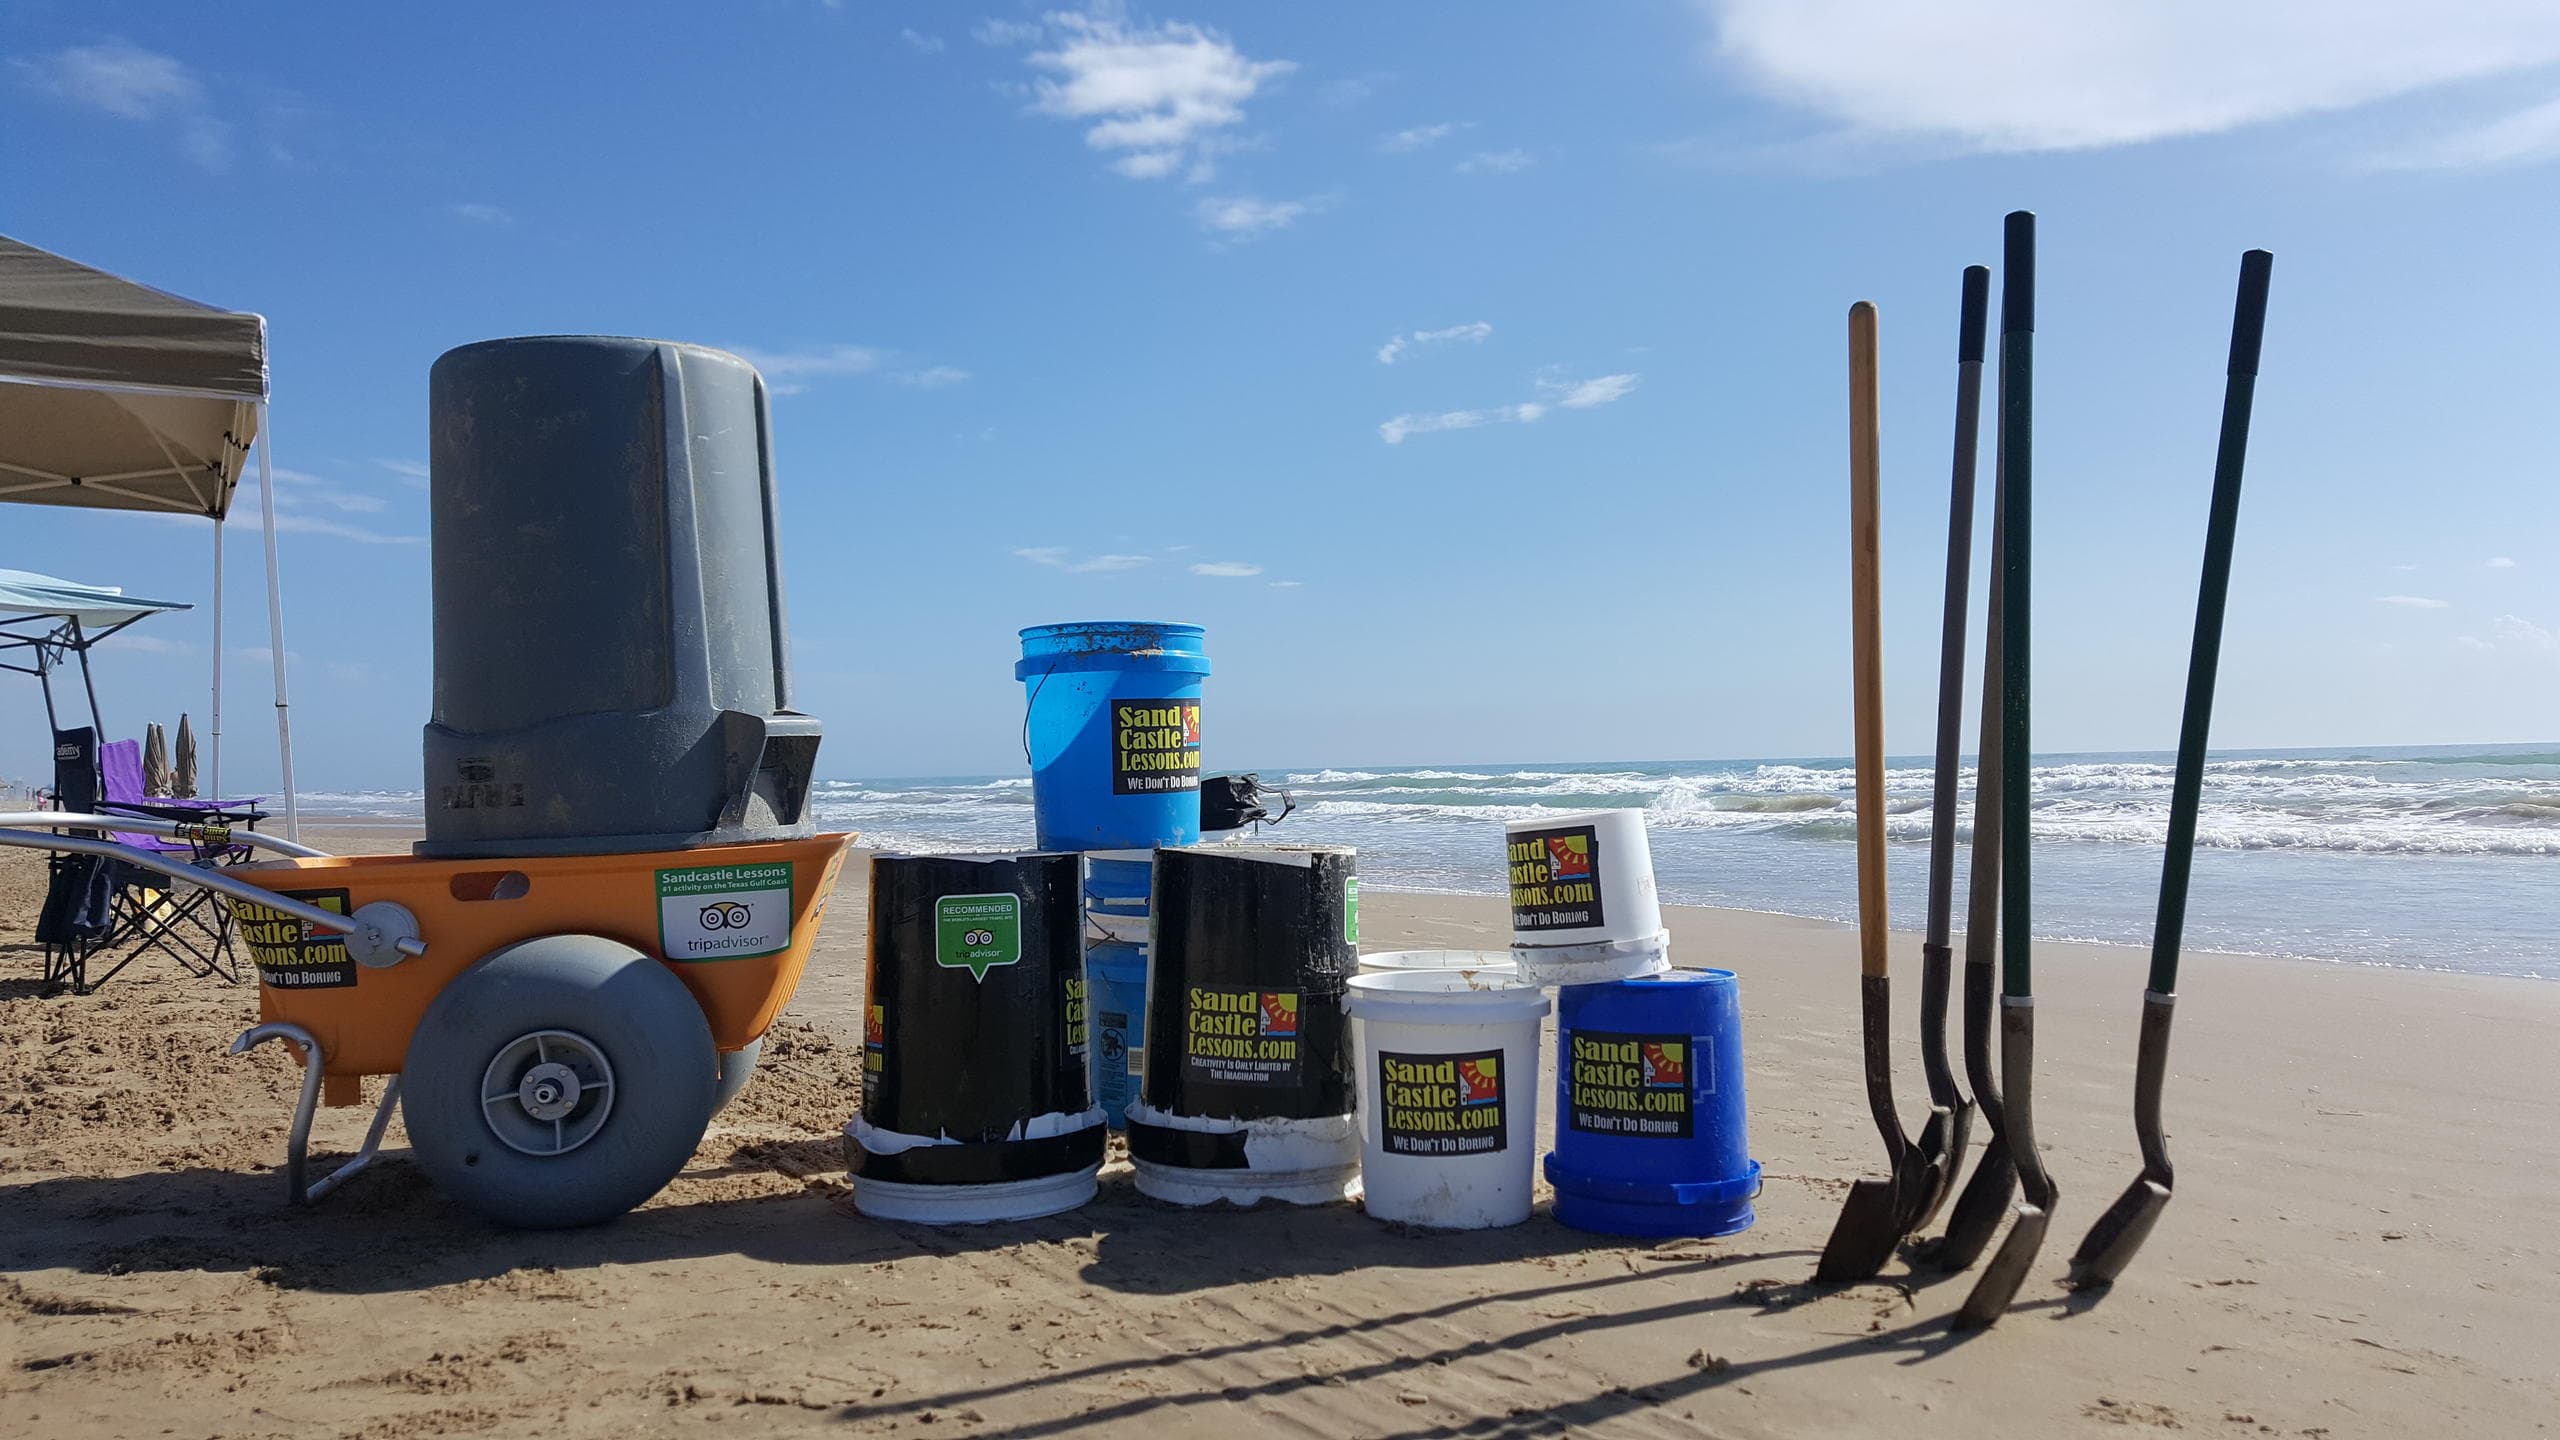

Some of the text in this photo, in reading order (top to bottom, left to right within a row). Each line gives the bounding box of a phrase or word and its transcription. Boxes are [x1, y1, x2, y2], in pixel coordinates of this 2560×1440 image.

[1119, 706, 1181, 727] Sand
[1120, 728, 1181, 750] Castle
[1128, 777, 1144, 790] WE
[1145, 776, 1169, 788] DON'T
[1170, 776, 1180, 788] DO
[662, 868, 786, 884] Sandcastle Lessons
[674, 883, 701, 892] activity
[767, 878, 787, 886] Coast
[944, 904, 1012, 914] RECOMMENDED
[1520, 912, 1538, 926] DON'T
[1539, 912, 1550, 925] DO
[1552, 910, 1589, 924] BORING
[238, 922, 298, 944] astle
[688, 935, 764, 952] tripadvisor
[250, 944, 347, 966] ssons.com
[956, 950, 1000, 959] tripadvisor
[285, 972, 299, 984] DO
[302, 971, 341, 984] BORING
[1190, 988, 1257, 1014] Sand
[1189, 1011, 1256, 1036] Castle
[1188, 1032, 1296, 1060] Lessons.com
[1574, 1036, 1640, 1063] Sand
[1191, 1056, 1226, 1069] CREATIVITY
[1227, 1060, 1234, 1069] IS
[1235, 1060, 1254, 1070] ONLY
[1254, 1061, 1281, 1071] LIMITED
[1385, 1059, 1456, 1084] Sand
[1574, 1060, 1640, 1087] Castle
[1210, 1069, 1269, 1081] THE IMAGINATION
[1386, 1083, 1457, 1108] Castle
[1575, 1083, 1685, 1112] Lessons.com
[1387, 1106, 1499, 1131] Lessons.com
[1579, 1113, 1679, 1133] WE DON'T DO BORING
[1393, 1136, 1494, 1152] WE DON'T DO BORING
